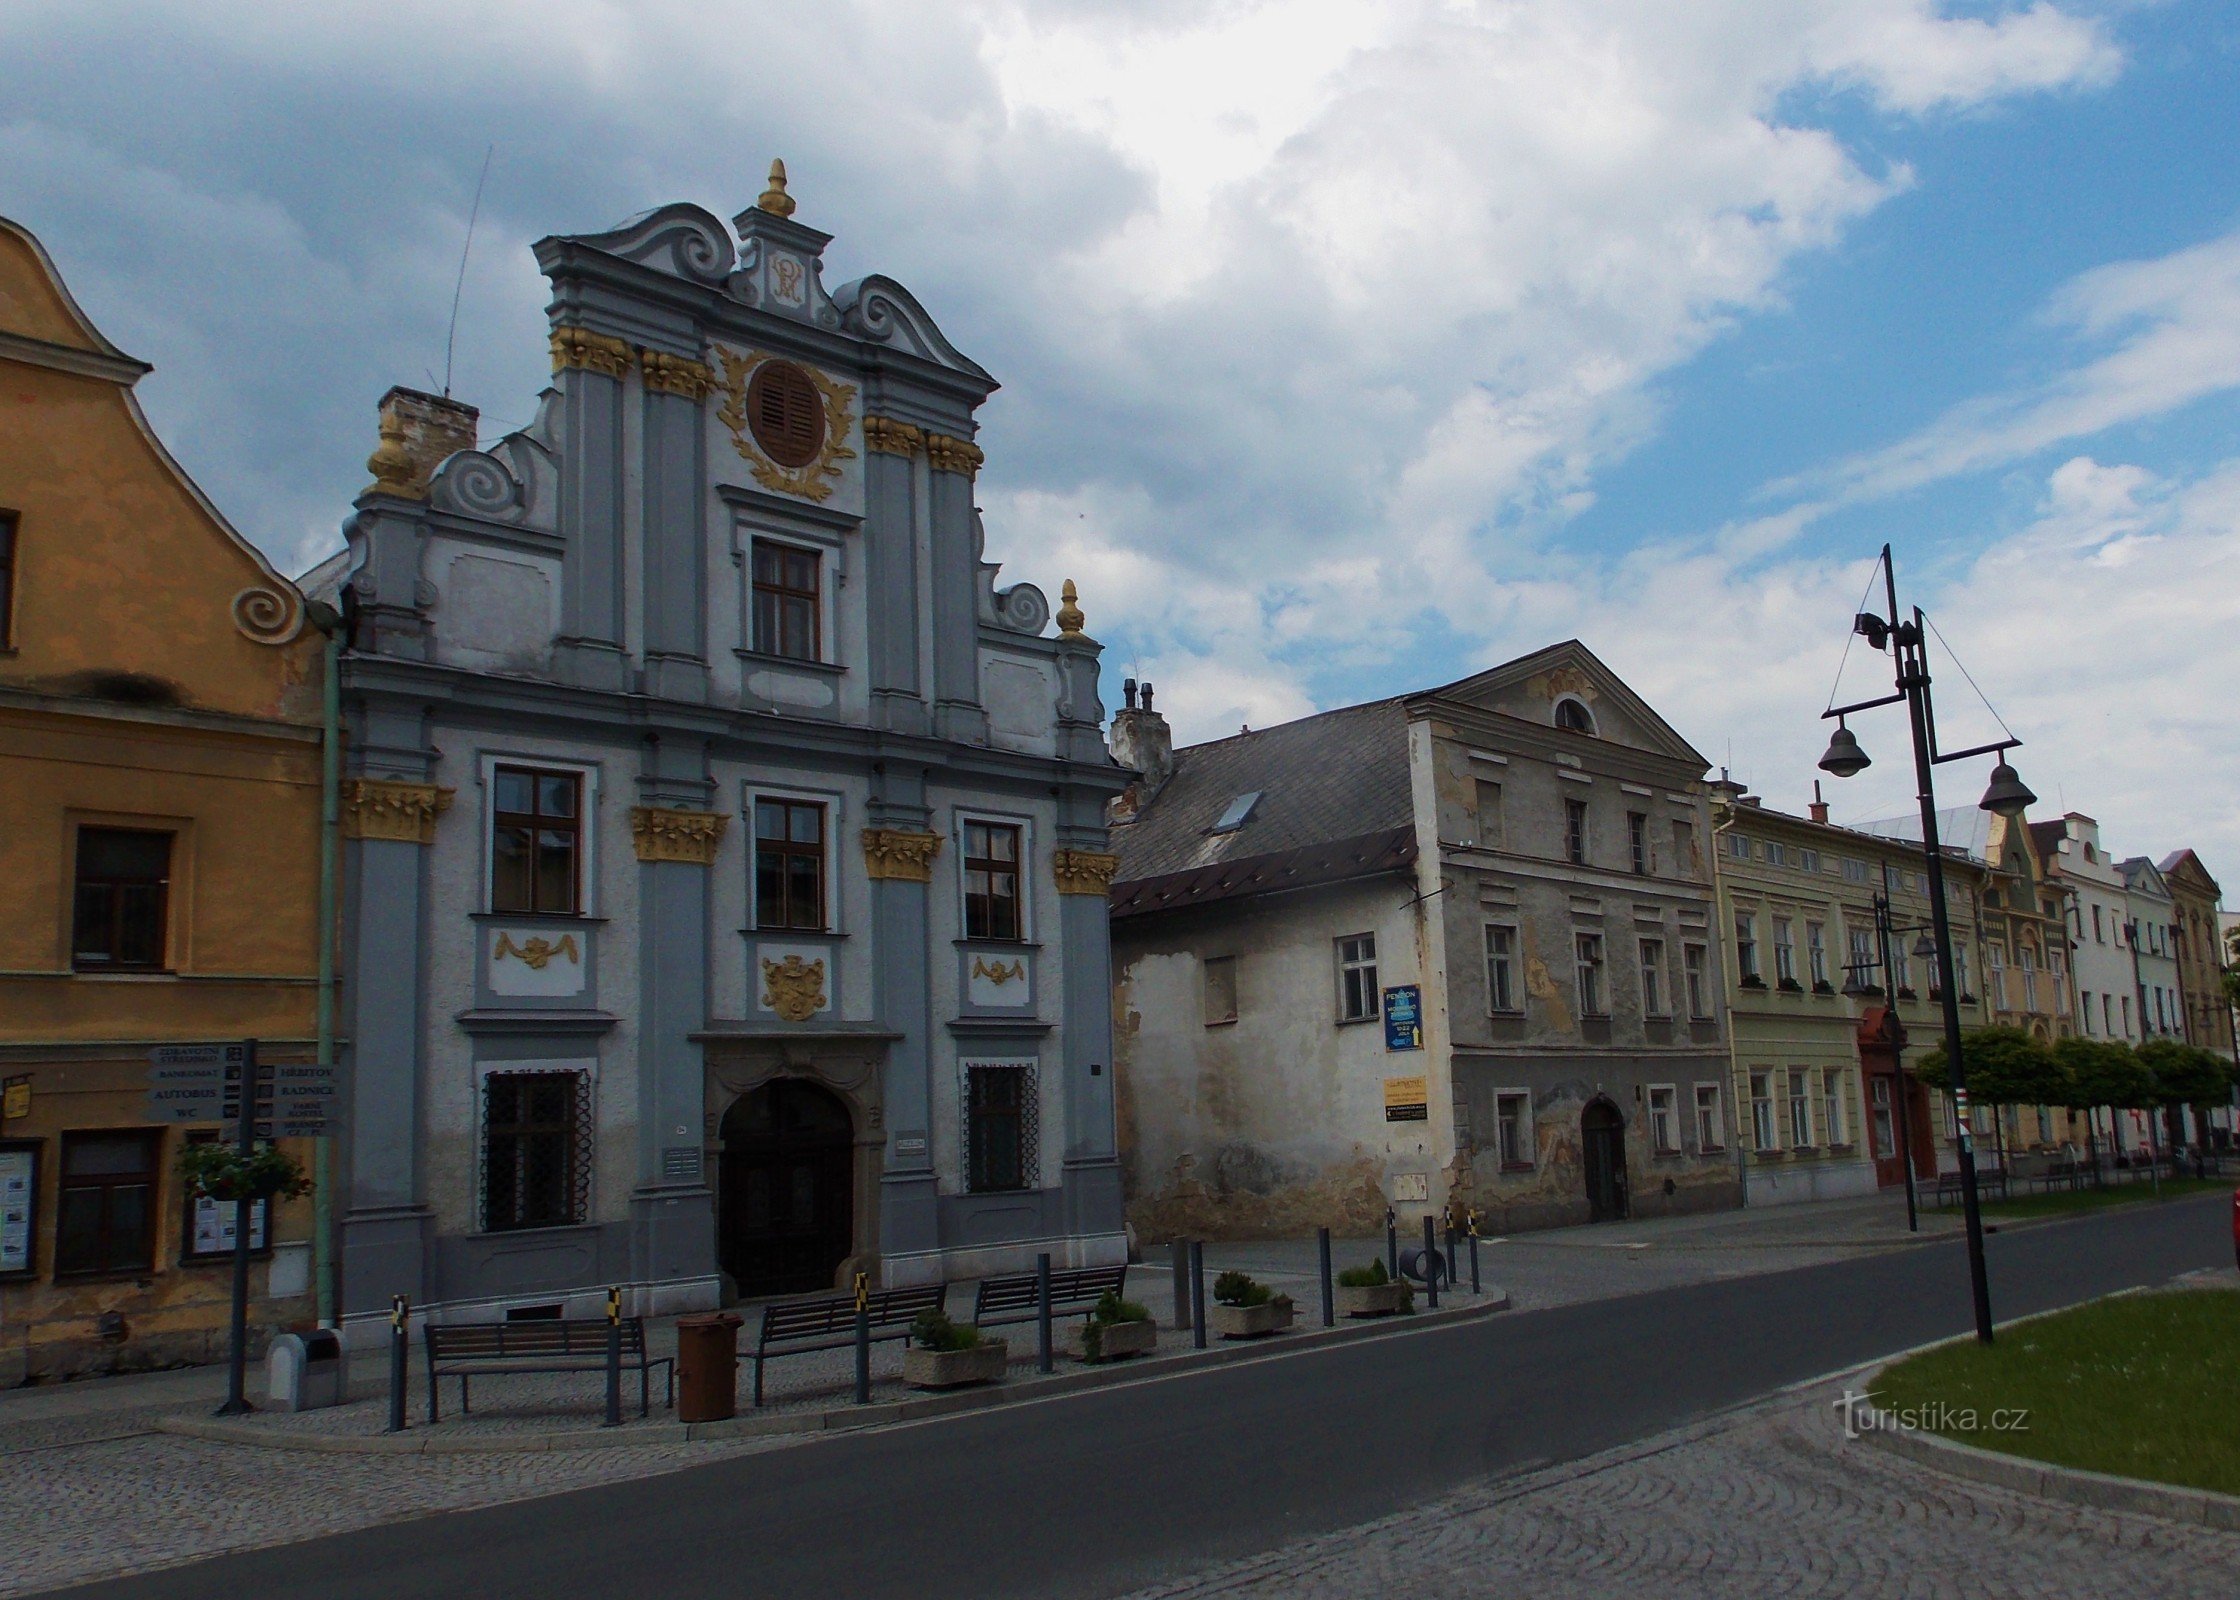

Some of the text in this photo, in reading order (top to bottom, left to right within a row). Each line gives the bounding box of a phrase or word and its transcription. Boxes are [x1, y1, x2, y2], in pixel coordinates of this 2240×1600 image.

[159, 1069, 218, 1079] BANKOMAT
[154, 1089, 217, 1099] AUTOBUS
[281, 1086, 335, 1095] RADNICE
[176, 1108, 198, 1118] WC
